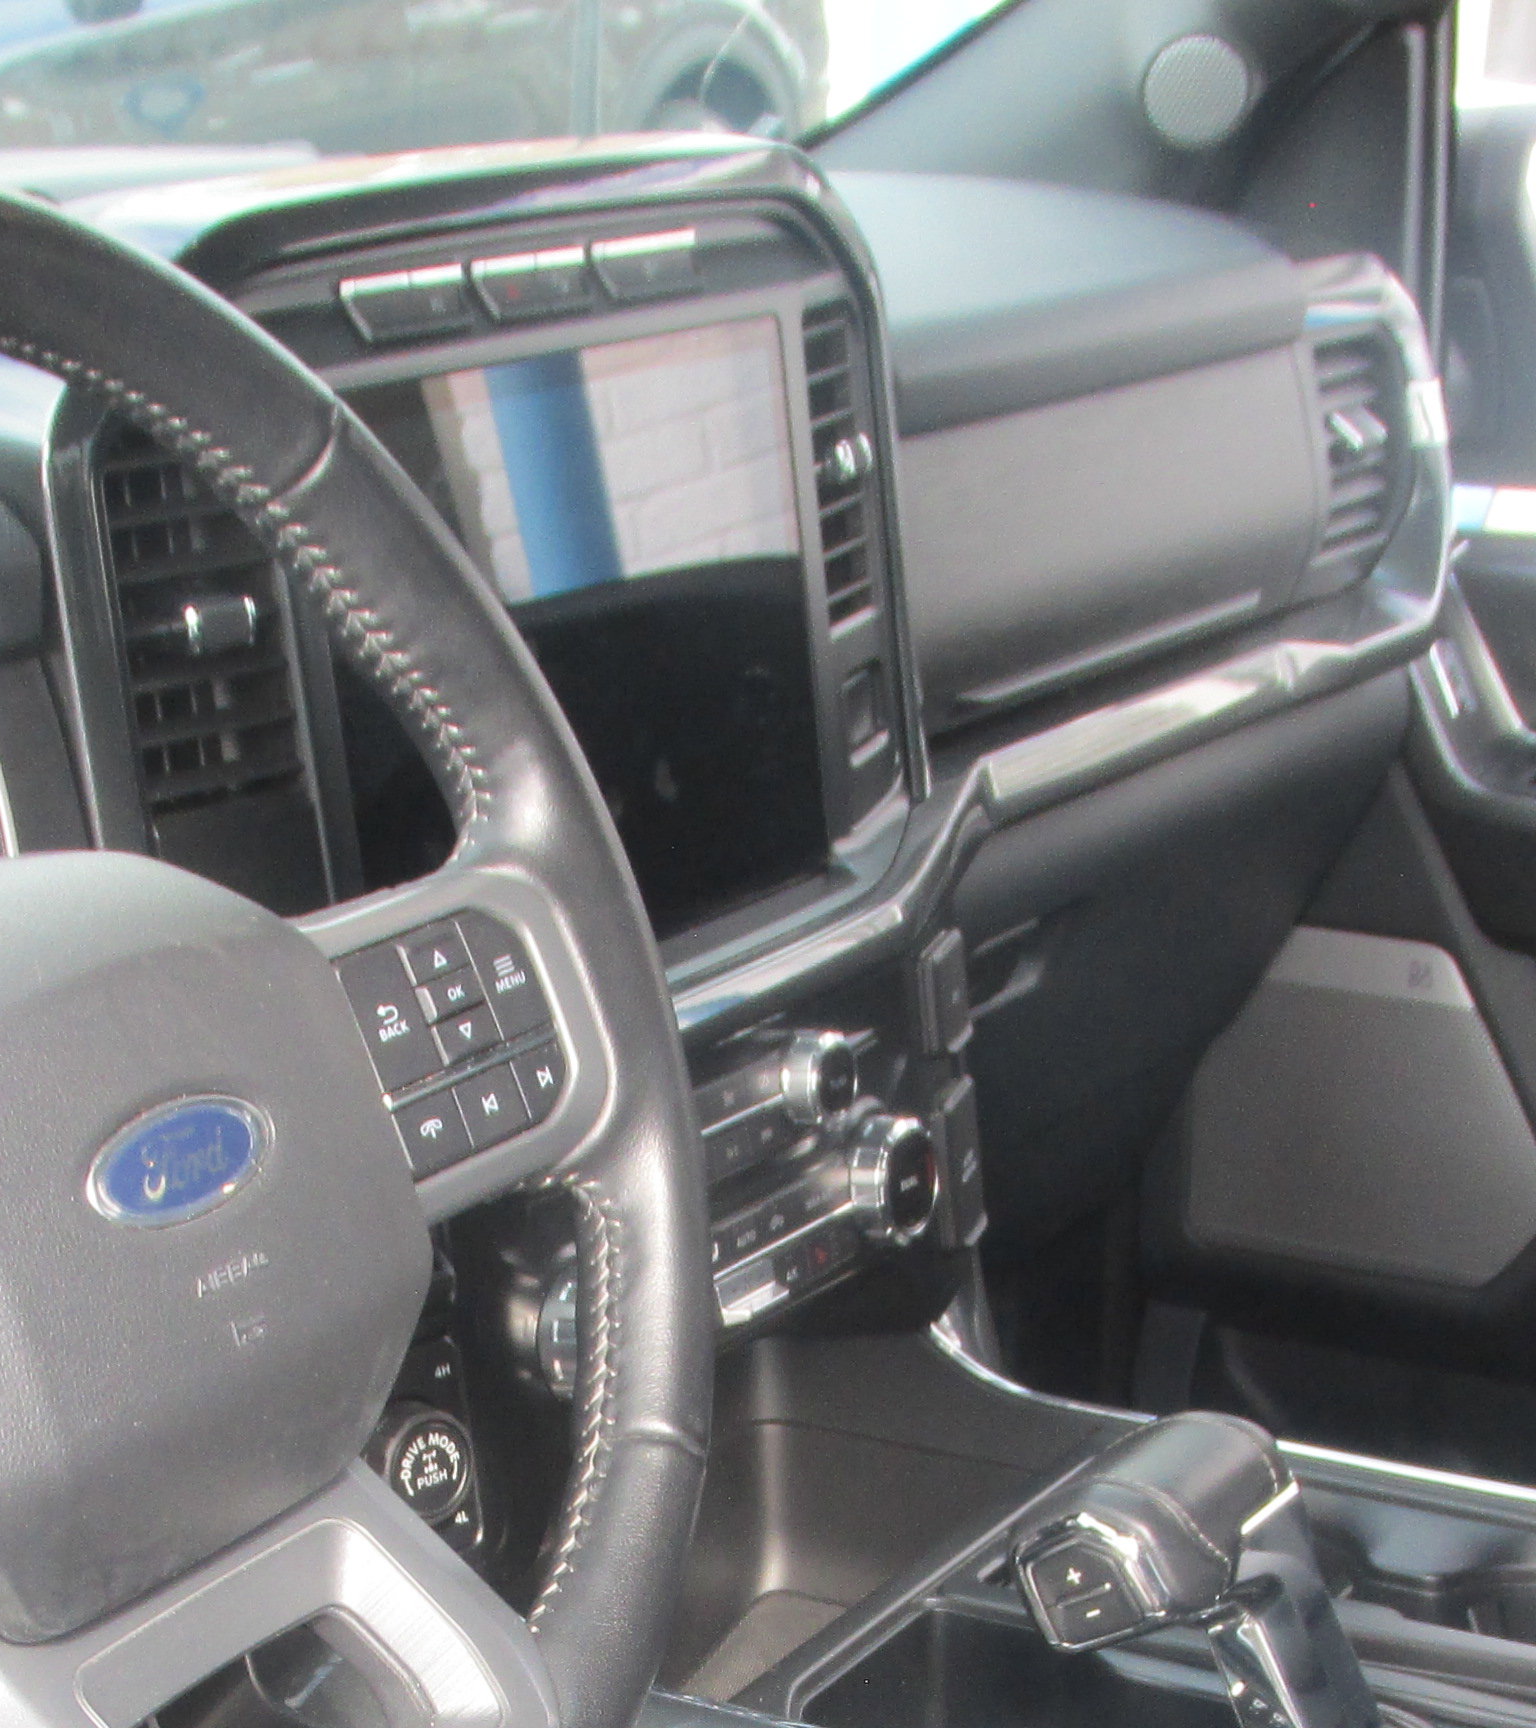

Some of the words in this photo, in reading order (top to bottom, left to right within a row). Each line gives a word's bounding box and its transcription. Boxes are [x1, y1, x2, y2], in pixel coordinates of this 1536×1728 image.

[495, 971, 526, 993] MENU
[447, 985, 465, 1000] OK
[378, 1022, 410, 1042] BACK
[435, 1364, 450, 1379] 4H
[400, 1435, 426, 1481] DRIVE
[427, 1432, 460, 1463] MODE
[416, 1467, 448, 1490] PUSH
[455, 1510, 469, 1524] 4L
